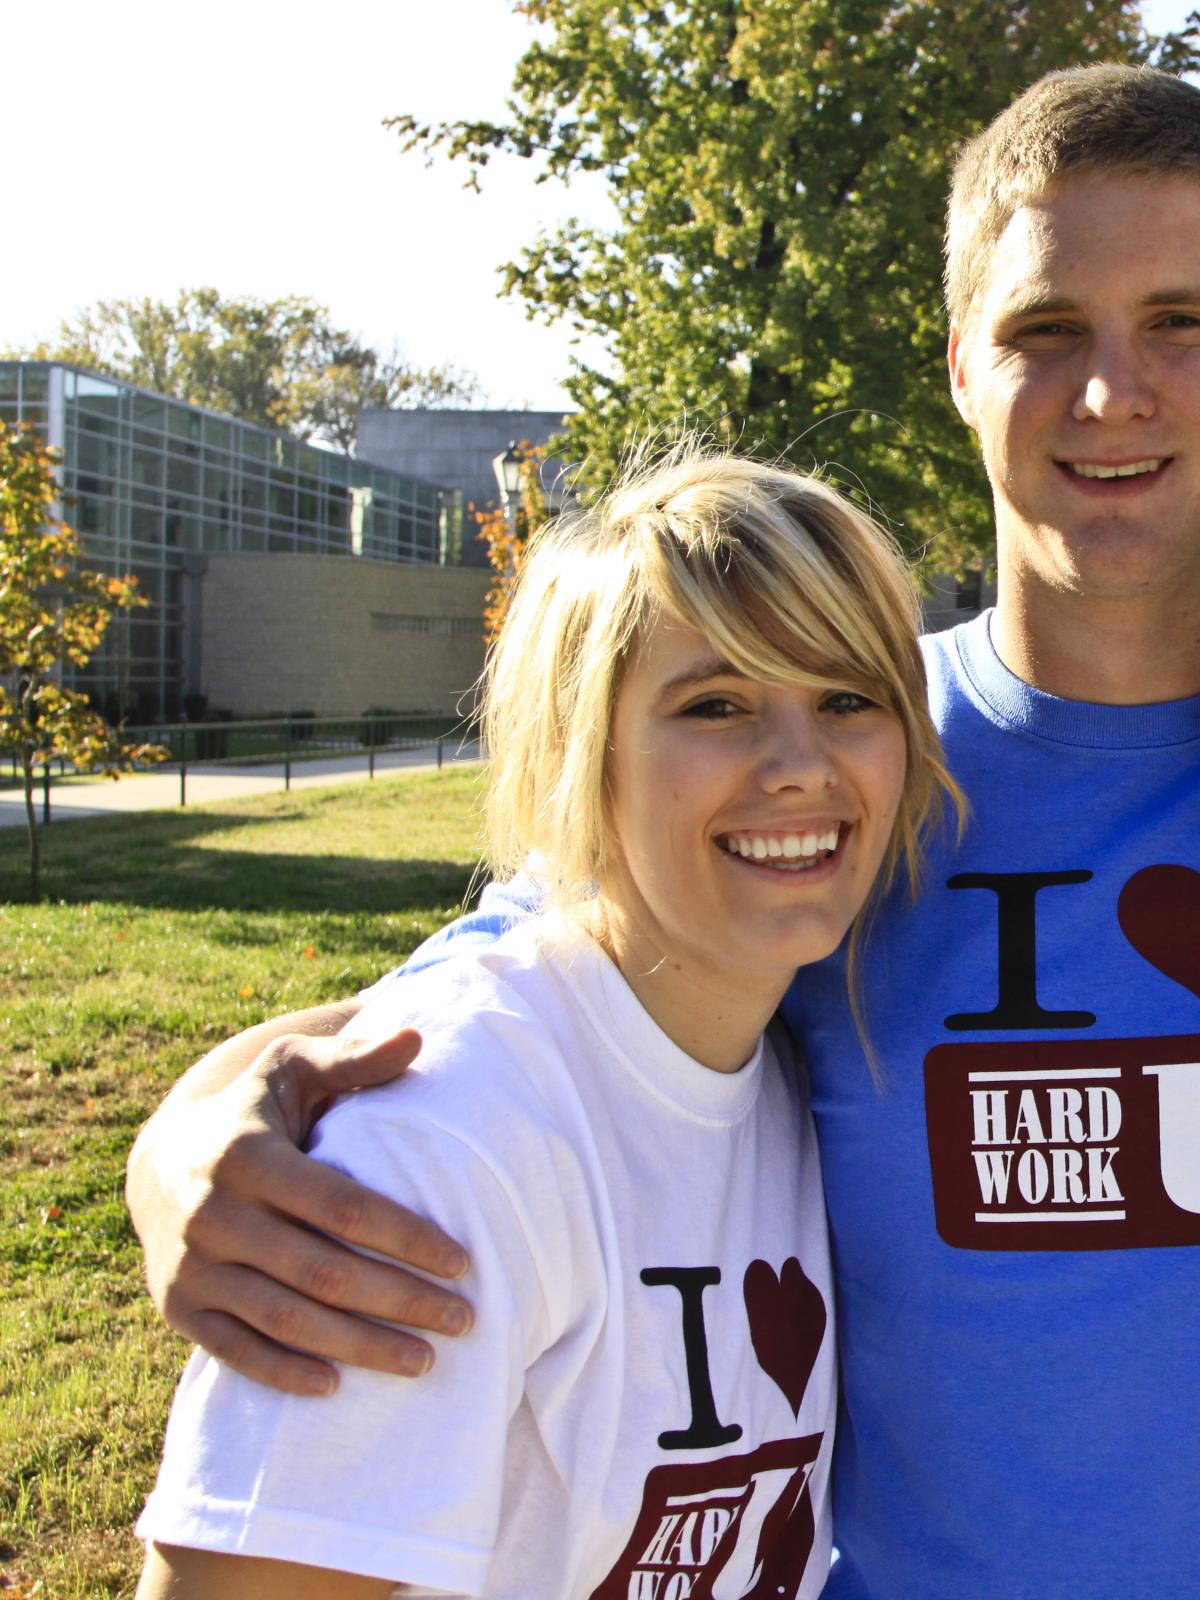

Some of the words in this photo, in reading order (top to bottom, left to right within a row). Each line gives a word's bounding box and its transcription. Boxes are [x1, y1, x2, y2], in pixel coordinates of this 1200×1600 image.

[943, 869, 1096, 1031] I
[969, 1086, 1122, 1145] HARD
[971, 1146, 1125, 1205] WORK
[640, 1266, 743, 1450] I
